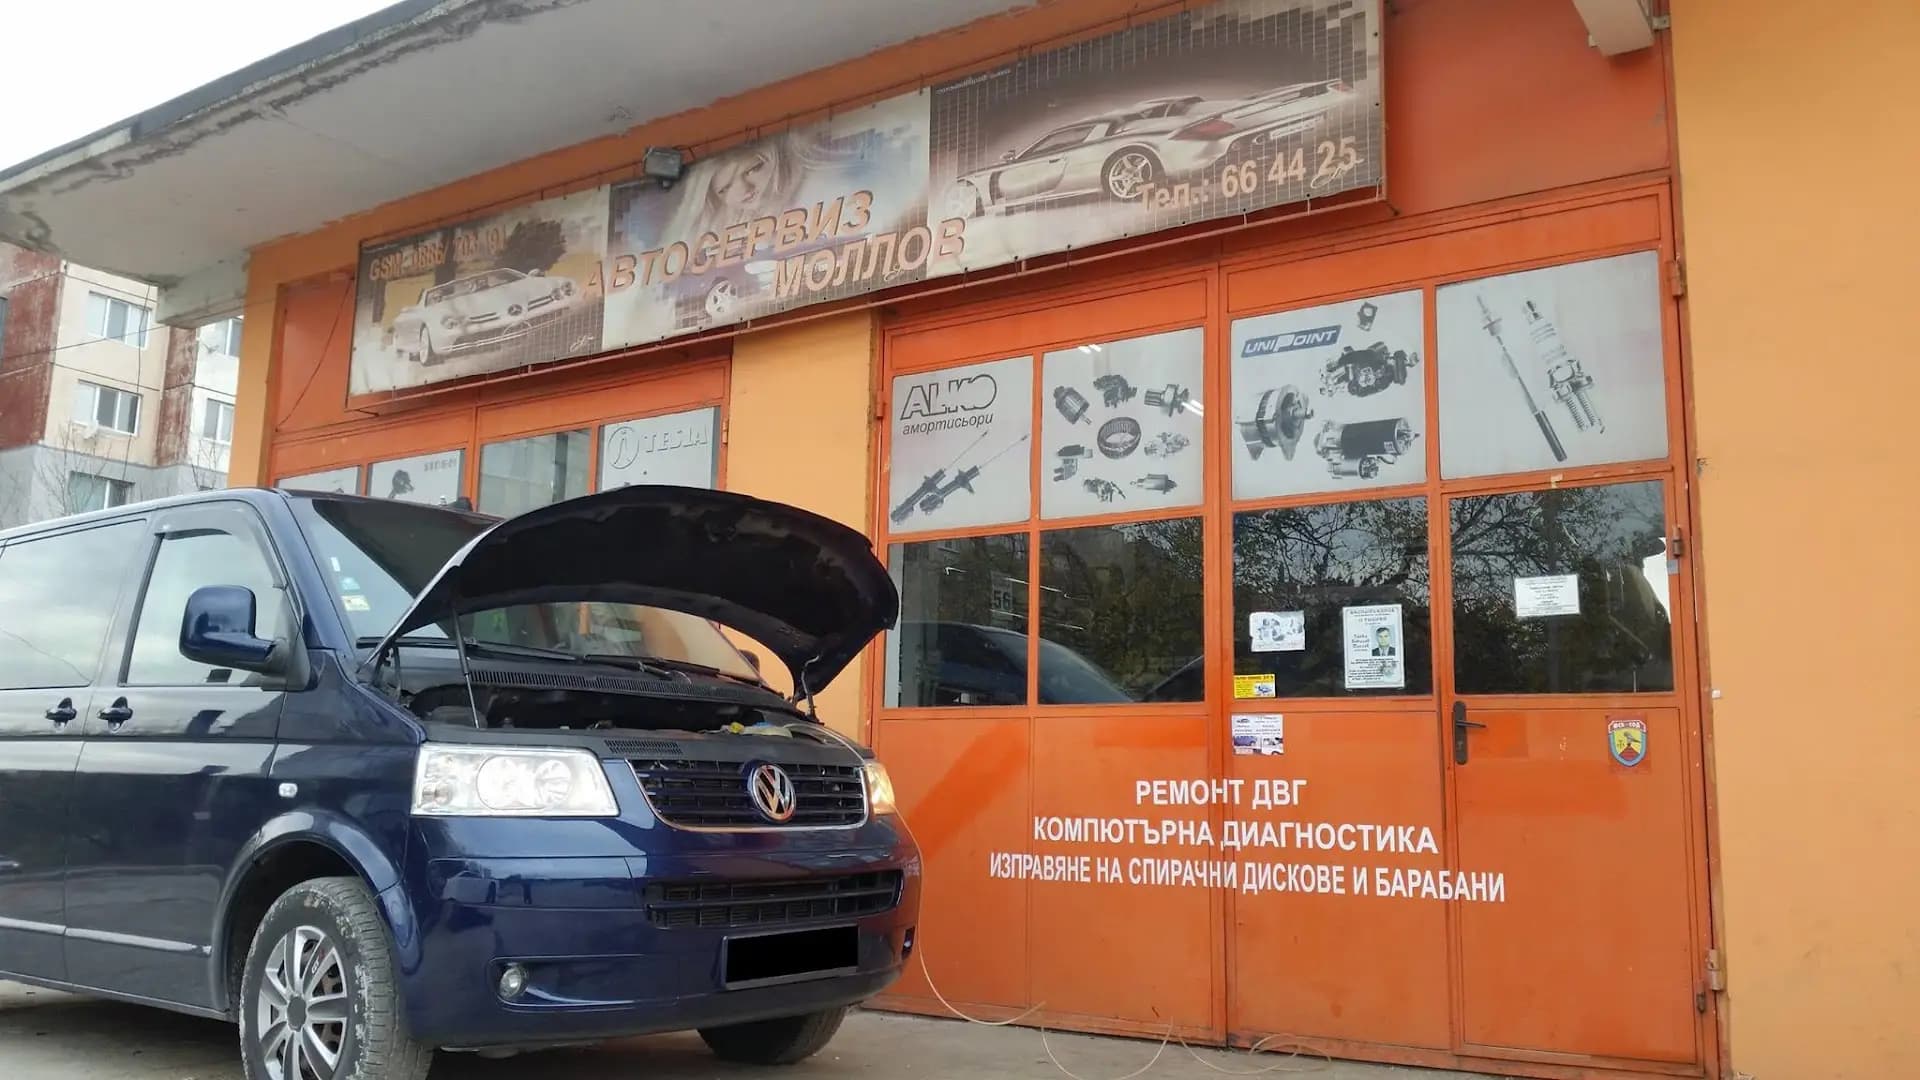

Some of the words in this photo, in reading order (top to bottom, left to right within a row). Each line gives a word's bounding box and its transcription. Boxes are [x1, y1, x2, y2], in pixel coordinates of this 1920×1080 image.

[1221, 160, 1258, 198] 66
[1268, 148, 1307, 186] 44
[1317, 136, 1358, 178] 25
[582, 190, 874, 302] АВТОСЕРВИЗ
[773, 217, 967, 298] МОЛЛОВ
[1244, 330, 1337, 354] UNIPOINT
[902, 413, 994, 435] амортисьори
[1135, 779, 1245, 805] РЕМОНТ
[1252, 779, 1308, 809] ДВГ
[1033, 816, 1211, 846] КОМПЮТЪРНА
[1221, 821, 1439, 854] ДИАГНОСТИКА
[989, 852, 1091, 882] ИЗПРАВЯНЕ
[1097, 857, 1123, 883] НА
[1128, 858, 1237, 889] СПИРАЧНИ
[1243, 862, 1345, 895] ДИСКОВЕ
[1352, 868, 1369, 895] И
[1375, 866, 1505, 902] БАРАБАНИ
